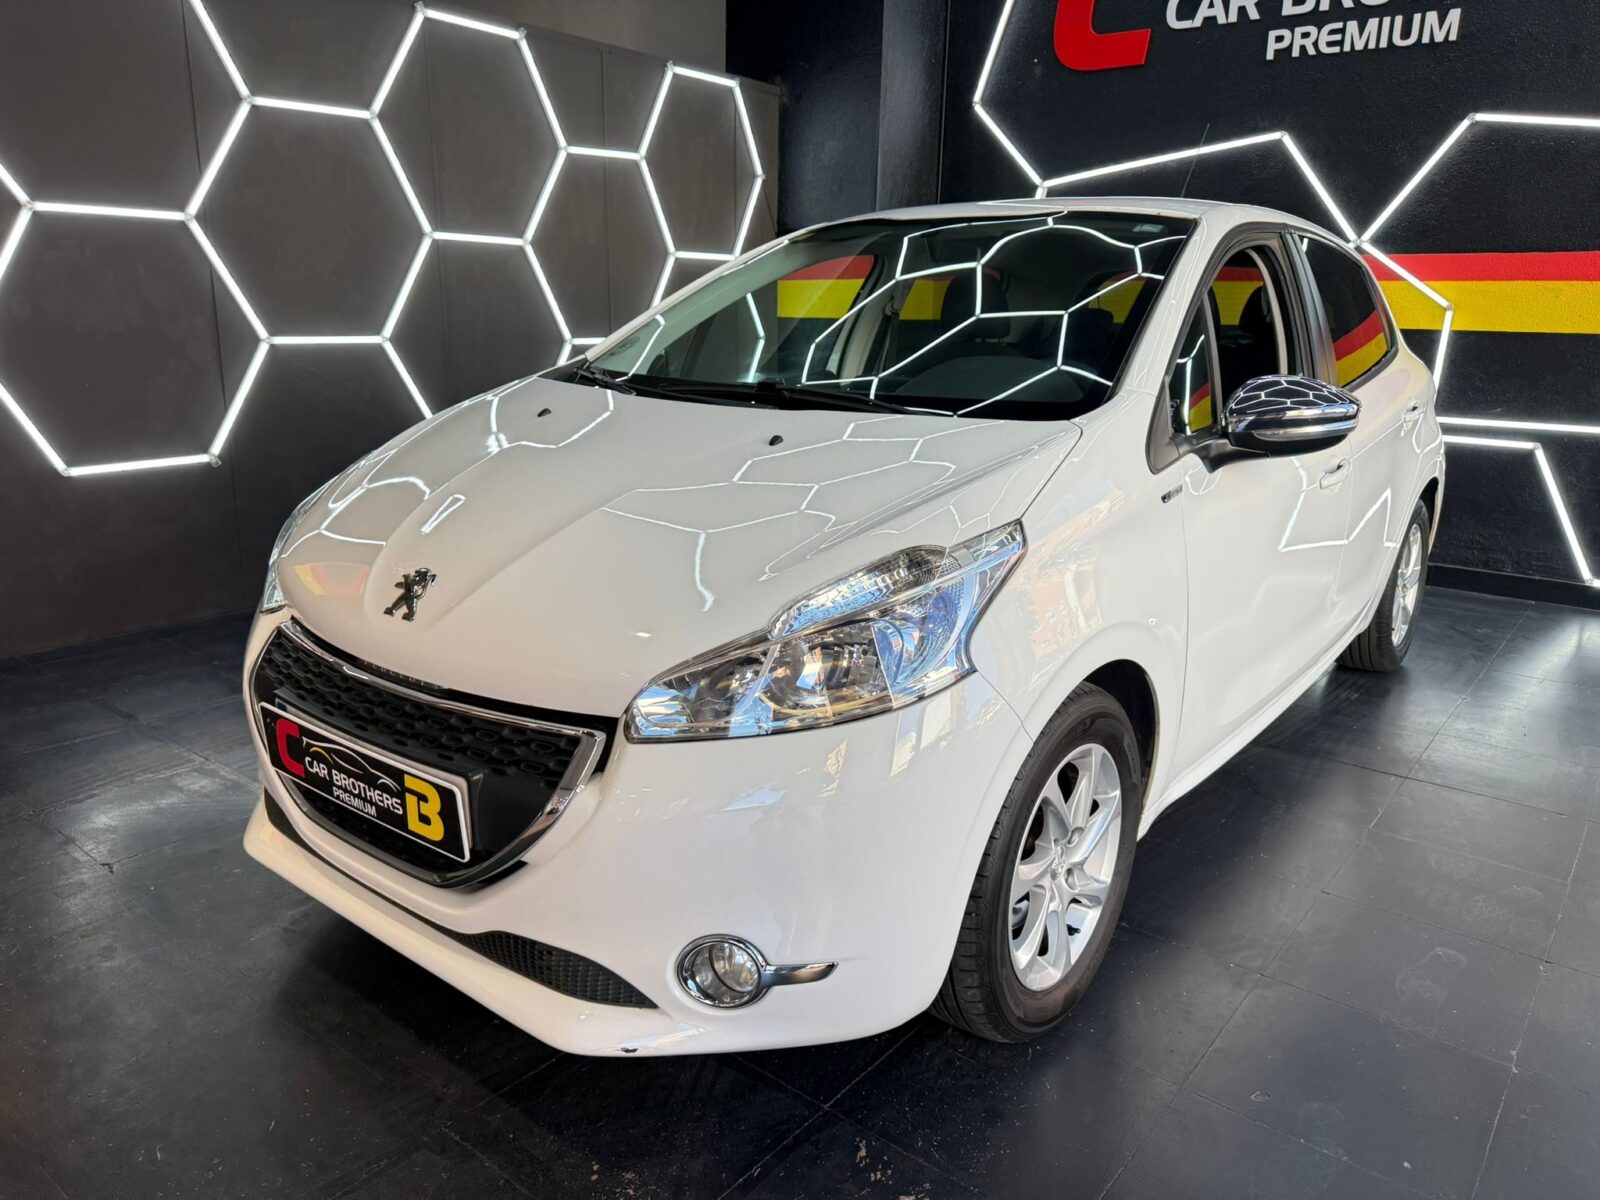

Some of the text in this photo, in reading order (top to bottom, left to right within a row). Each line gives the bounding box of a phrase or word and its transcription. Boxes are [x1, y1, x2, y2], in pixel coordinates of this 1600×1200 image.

[1266, 8, 1461, 60] PREMIUM
[305, 757, 403, 815] CAR BROTHERS
[333, 786, 377, 817] PREMIUM
